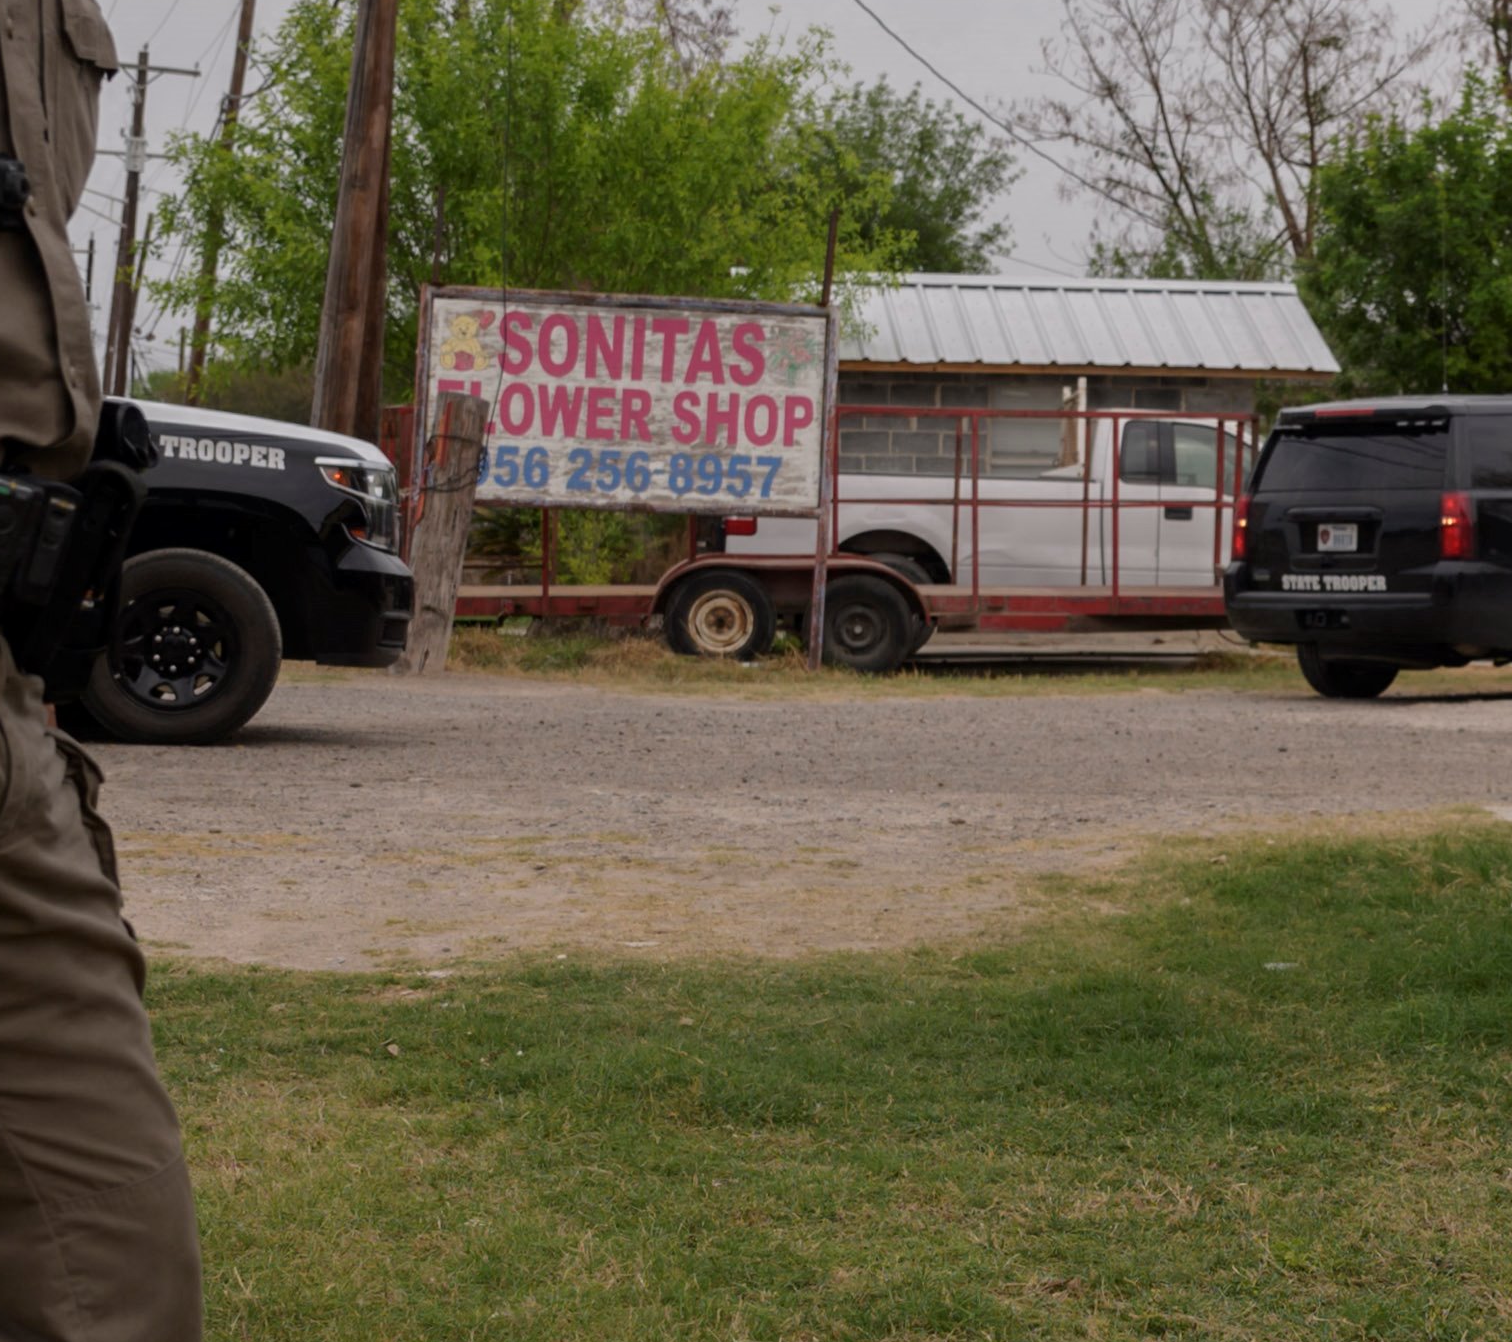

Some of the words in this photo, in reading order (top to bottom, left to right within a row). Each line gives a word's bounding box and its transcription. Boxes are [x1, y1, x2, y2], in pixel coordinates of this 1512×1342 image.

[497, 310, 766, 387] SONITAS
[671, 390, 814, 447] SHOP
[159, 434, 286, 470] TROOPER
[477, 445, 550, 489] 56
[565, 447, 784, 499] 256-8957
[1281, 574, 1320, 590] STATE
[1323, 575, 1386, 591] TROOPER
